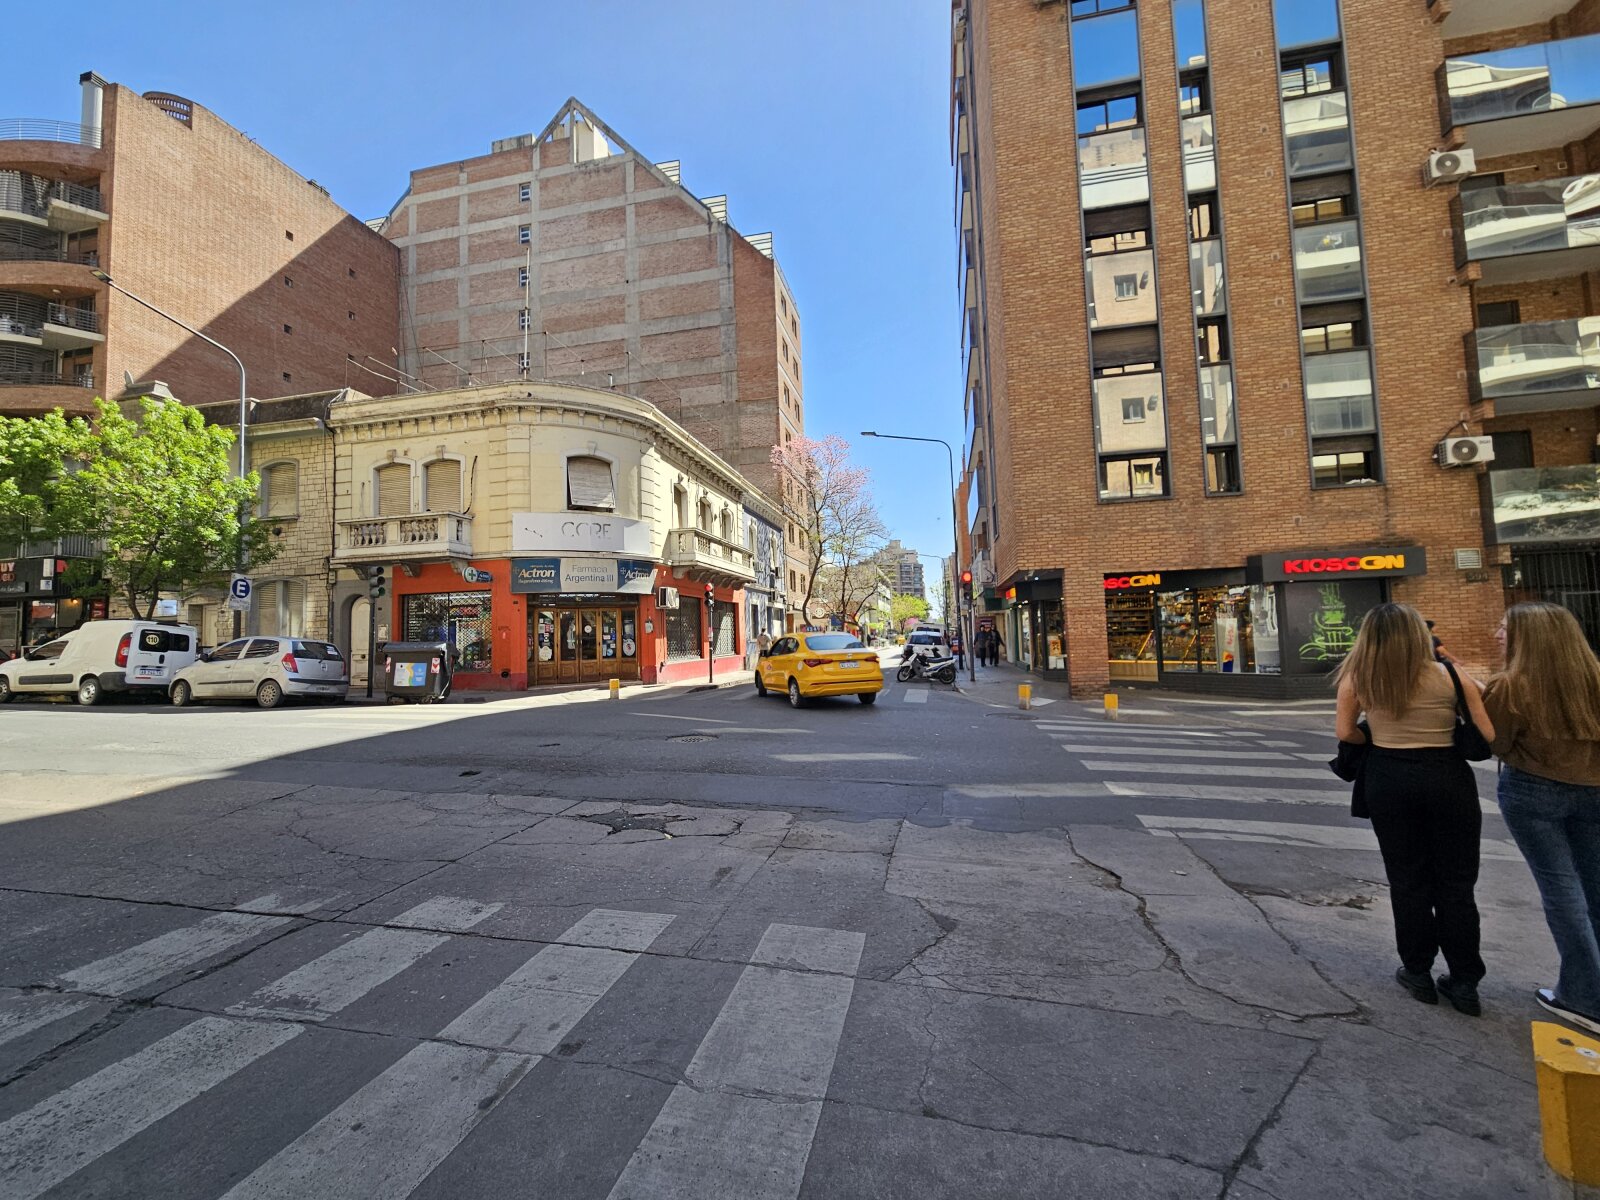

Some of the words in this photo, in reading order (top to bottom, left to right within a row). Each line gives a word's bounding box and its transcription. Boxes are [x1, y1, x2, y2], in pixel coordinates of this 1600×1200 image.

[518, 568, 556, 578] Actron
[572, 565, 608, 573] Farmacia
[565, 574, 605, 583] Argentina
[236, 580, 247, 597] E
